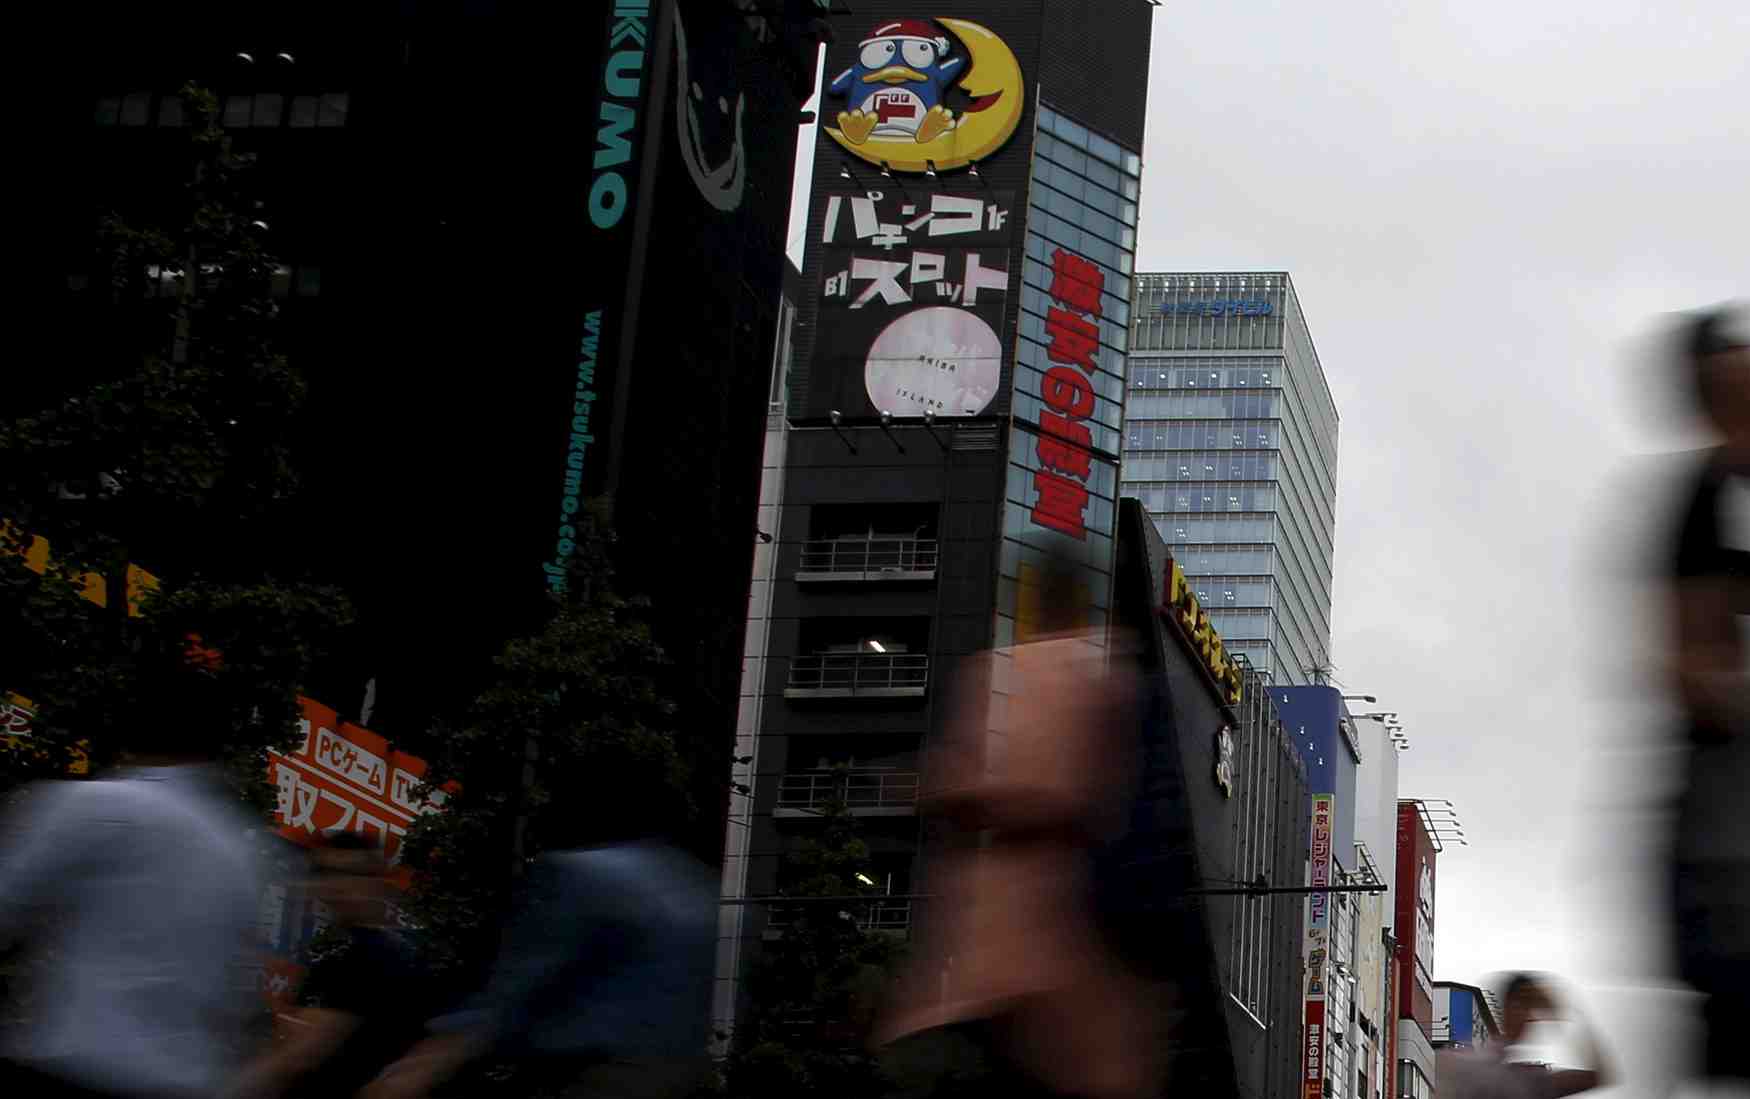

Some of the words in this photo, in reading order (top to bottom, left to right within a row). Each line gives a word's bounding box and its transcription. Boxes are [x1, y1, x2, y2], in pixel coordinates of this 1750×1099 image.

[822, 190, 984, 249] パチンコ
[848, 251, 1009, 309] スロット
